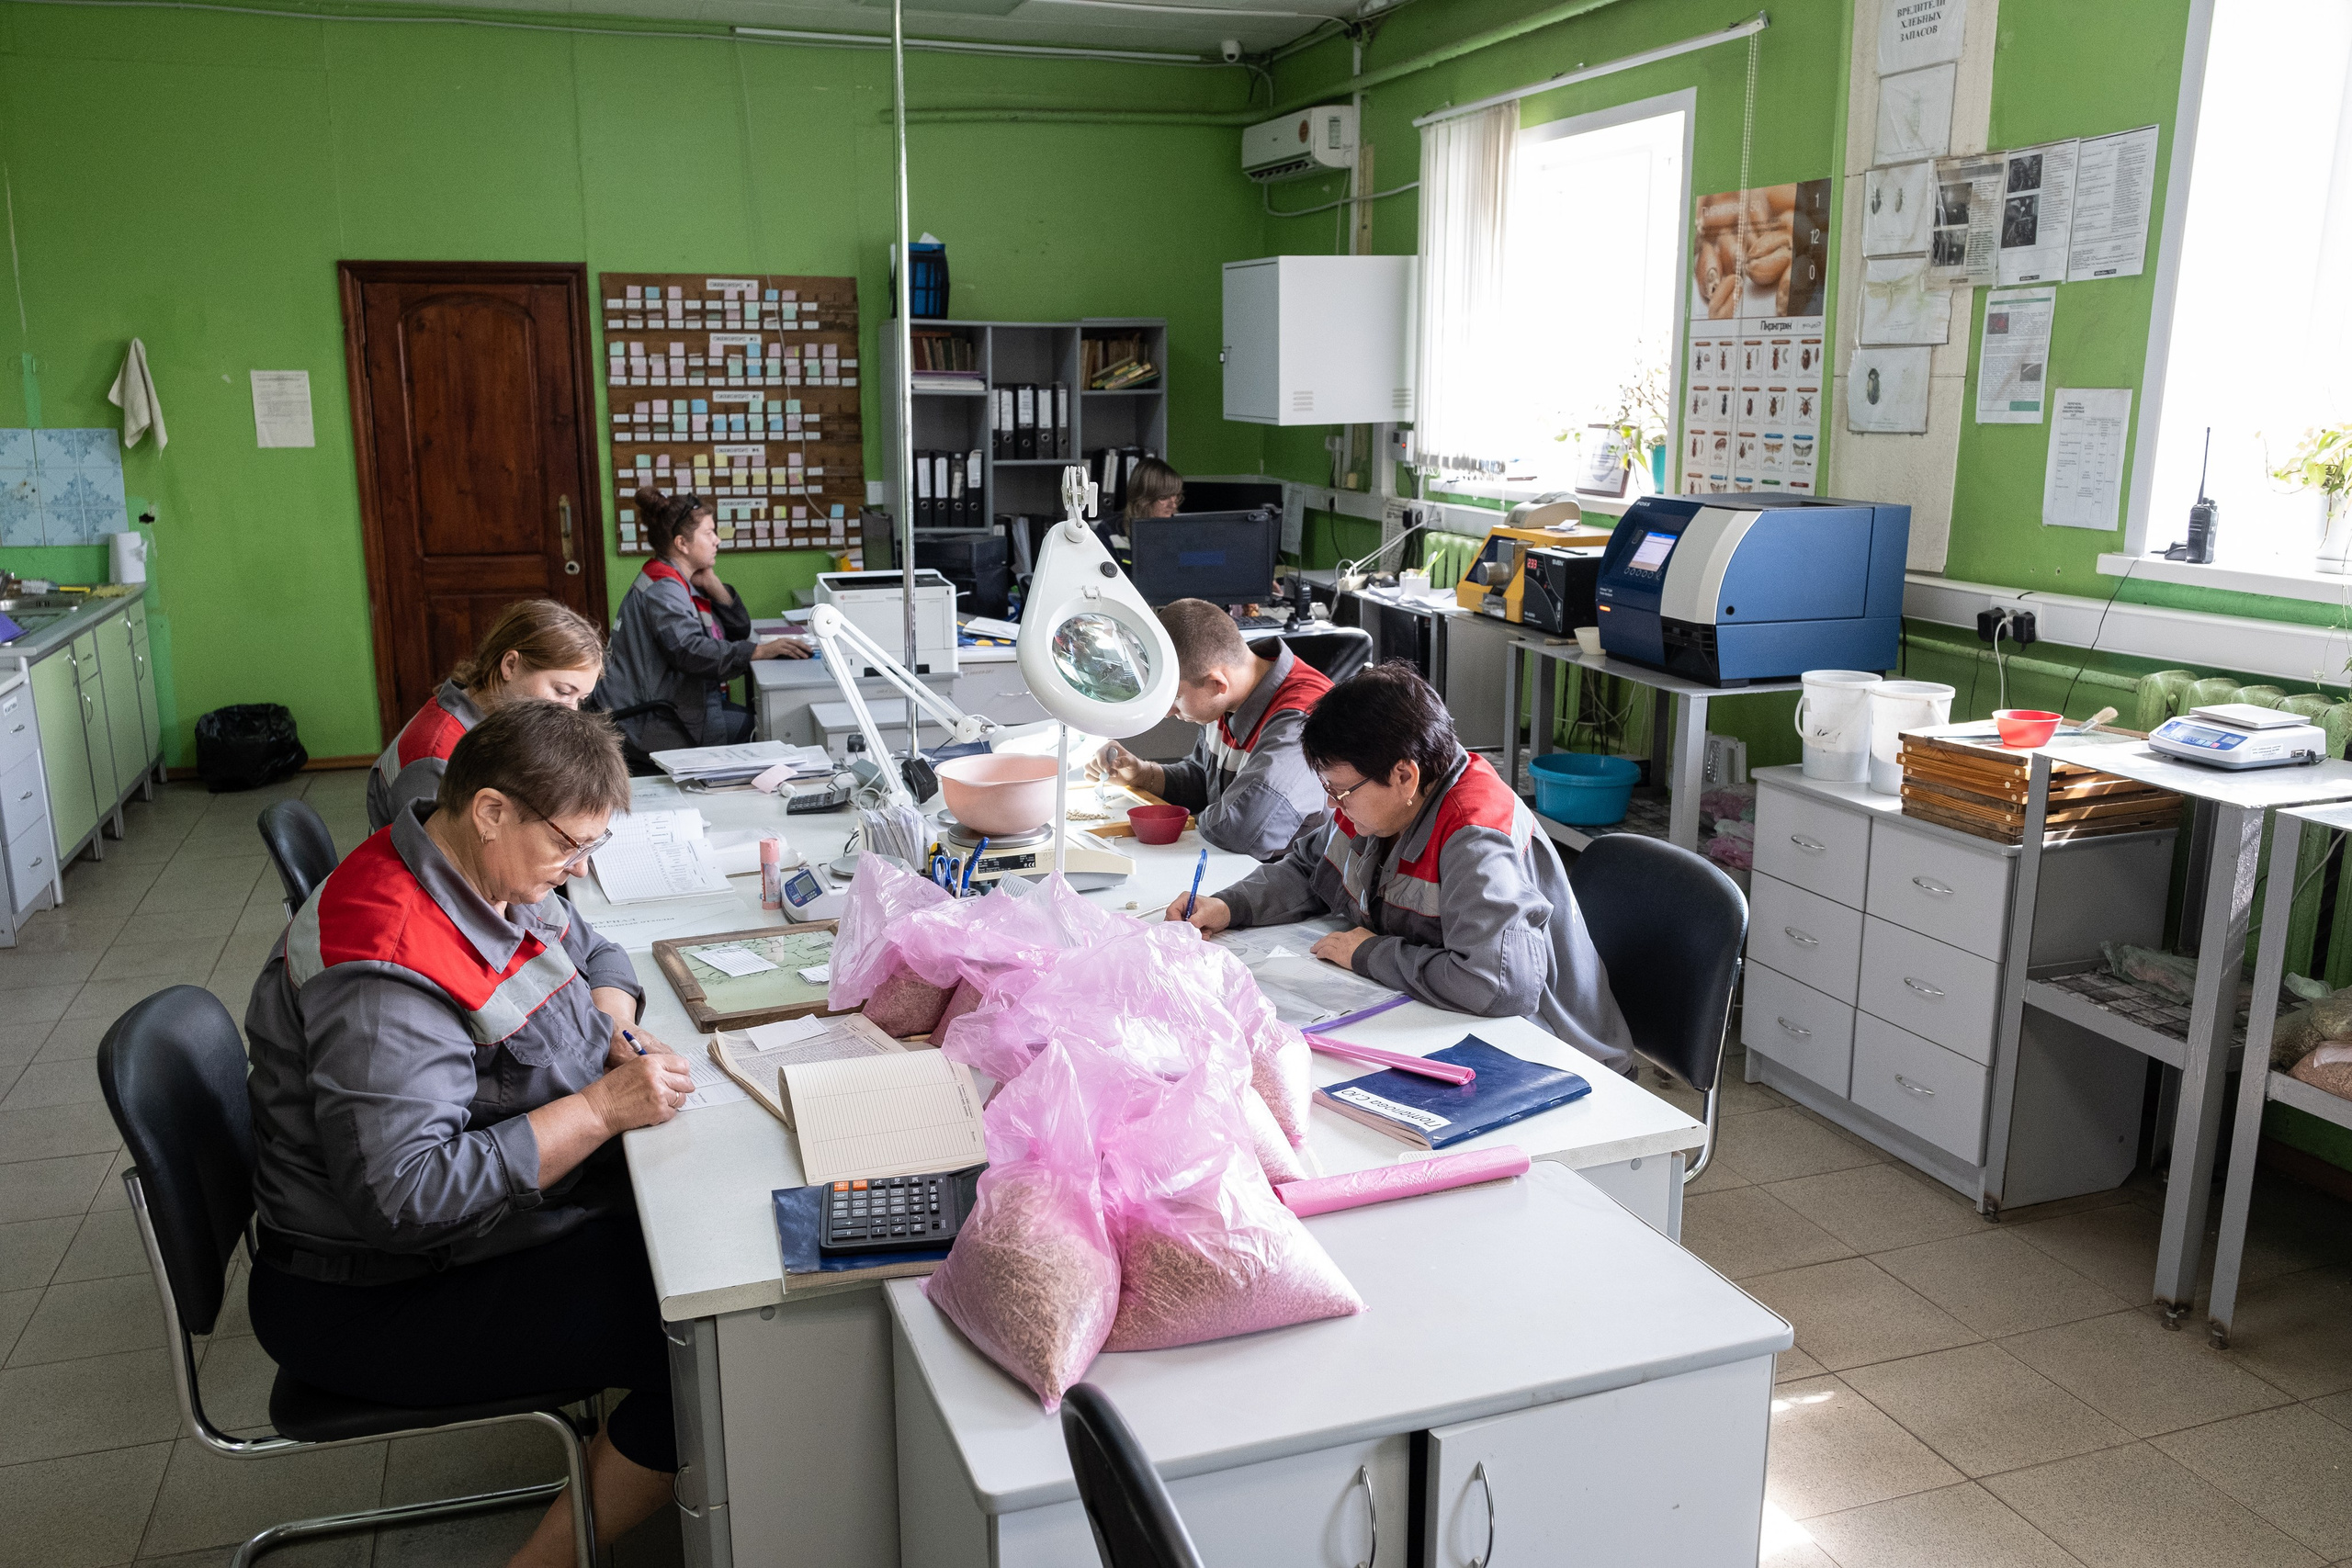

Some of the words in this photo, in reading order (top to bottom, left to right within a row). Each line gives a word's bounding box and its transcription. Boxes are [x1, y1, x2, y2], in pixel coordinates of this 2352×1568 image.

[1897, 0, 1946, 17] ВРЕДИТЕЛИ
[1901, 11, 1941, 28] ХЛЕБНЫХ
[1900, 25, 1938, 42] ЗАПАСОВ
[1815, 193, 1820, 208] 1
[1810, 229, 1820, 244] 12
[1809, 265, 1815, 280] 0
[1527, 558, 1537, 569] 233
[1370, 1099, 1441, 1128] Потапова
